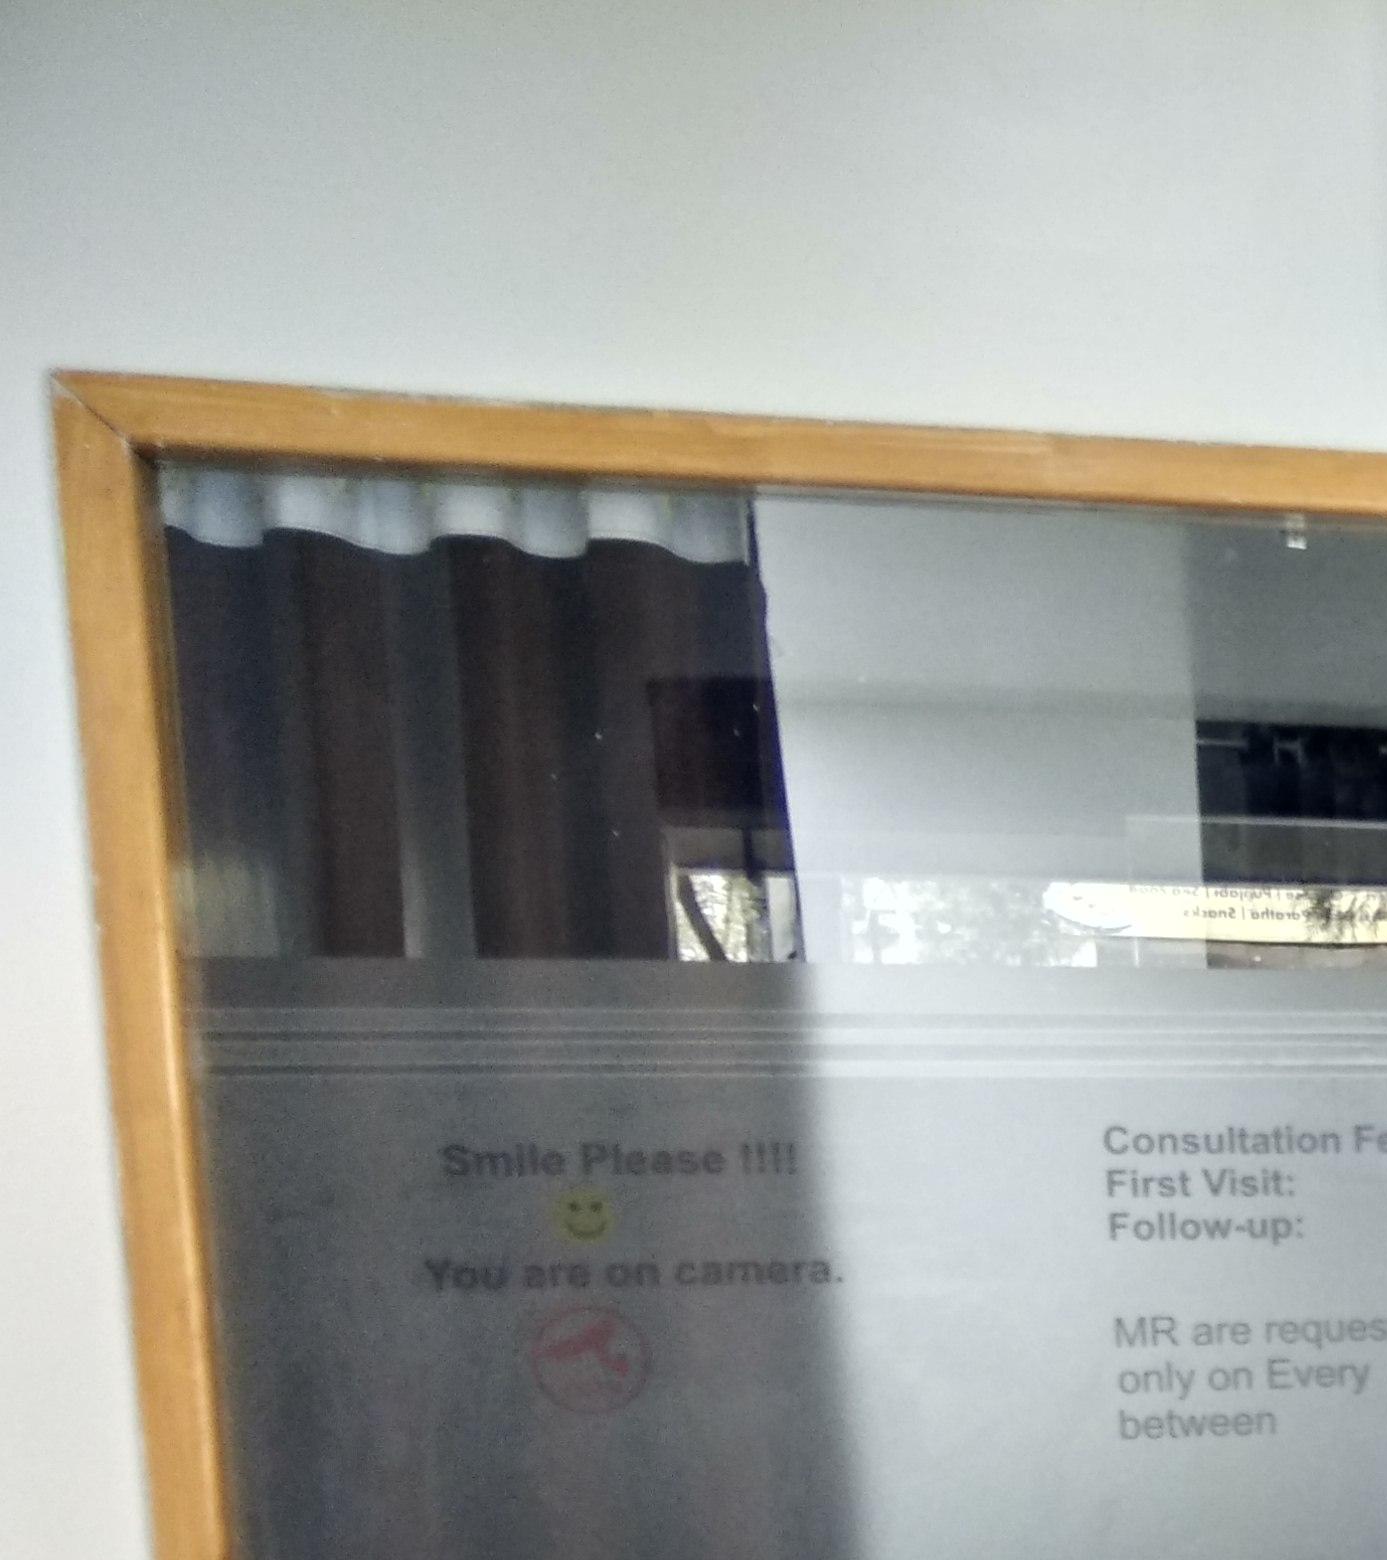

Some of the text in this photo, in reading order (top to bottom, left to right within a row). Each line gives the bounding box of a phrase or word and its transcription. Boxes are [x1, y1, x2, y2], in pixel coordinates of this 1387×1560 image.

[1102, 1124, 1341, 1156] Consultation
[436, 1142, 566, 1179] Smile
[579, 1141, 726, 1177] Please
[1105, 1166, 1295, 1198] First Visit:
[1108, 1210, 1304, 1246] Follow-up:
[423, 1256, 844, 1292] You are on camera.
[1114, 1315, 1178, 1349] MR
[1193, 1319, 1252, 1347] are
[1118, 1357, 1371, 1400] only on Every
[1118, 1407, 1278, 1441] between
